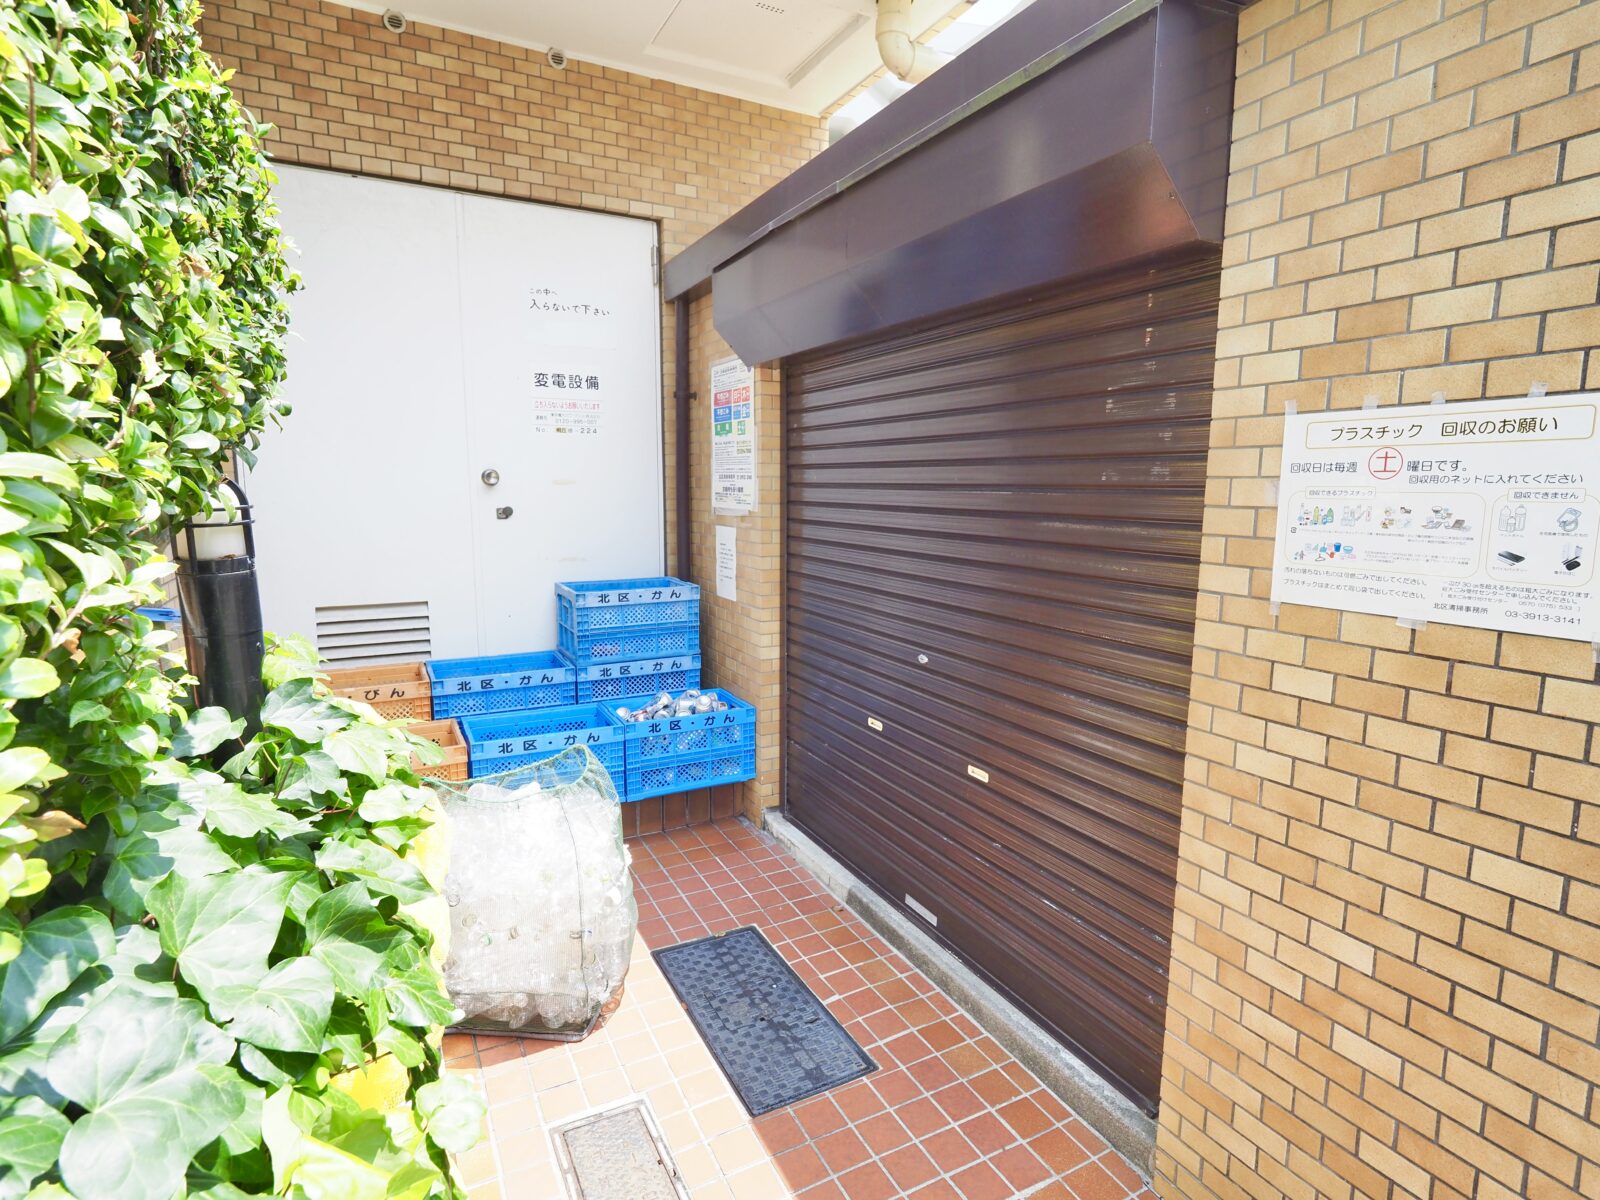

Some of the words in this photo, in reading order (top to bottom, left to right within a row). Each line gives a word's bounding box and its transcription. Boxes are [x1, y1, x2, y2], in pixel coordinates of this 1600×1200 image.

[529, 288, 558, 296] この中へ
[529, 299, 610, 316] 入らないで下さい
[534, 372, 600, 391] 変電設備
[1331, 423, 1423, 442] プラスチック
[1440, 416, 1559, 438] 回収のお願い
[1290, 461, 1358, 474] 回収日は毎週
[1373, 450, 1397, 473] 土
[1406, 459, 1468, 473] 曜日です。
[1408, 473, 1583, 485] 回収用のネットに入れてください
[1513, 491, 1579, 500] 回収できません
[598, 589, 682, 604] 北区・かん
[1433, 602, 1489, 615] 北区清掃事務所
[1504, 610, 1581, 625] 03-3913-3141
[600, 660, 682, 678] 北区・かん
[456, 673, 554, 692] 北区・かん
[648, 713, 736, 734] 北区・かん
[497, 732, 600, 755] 北区・かん
